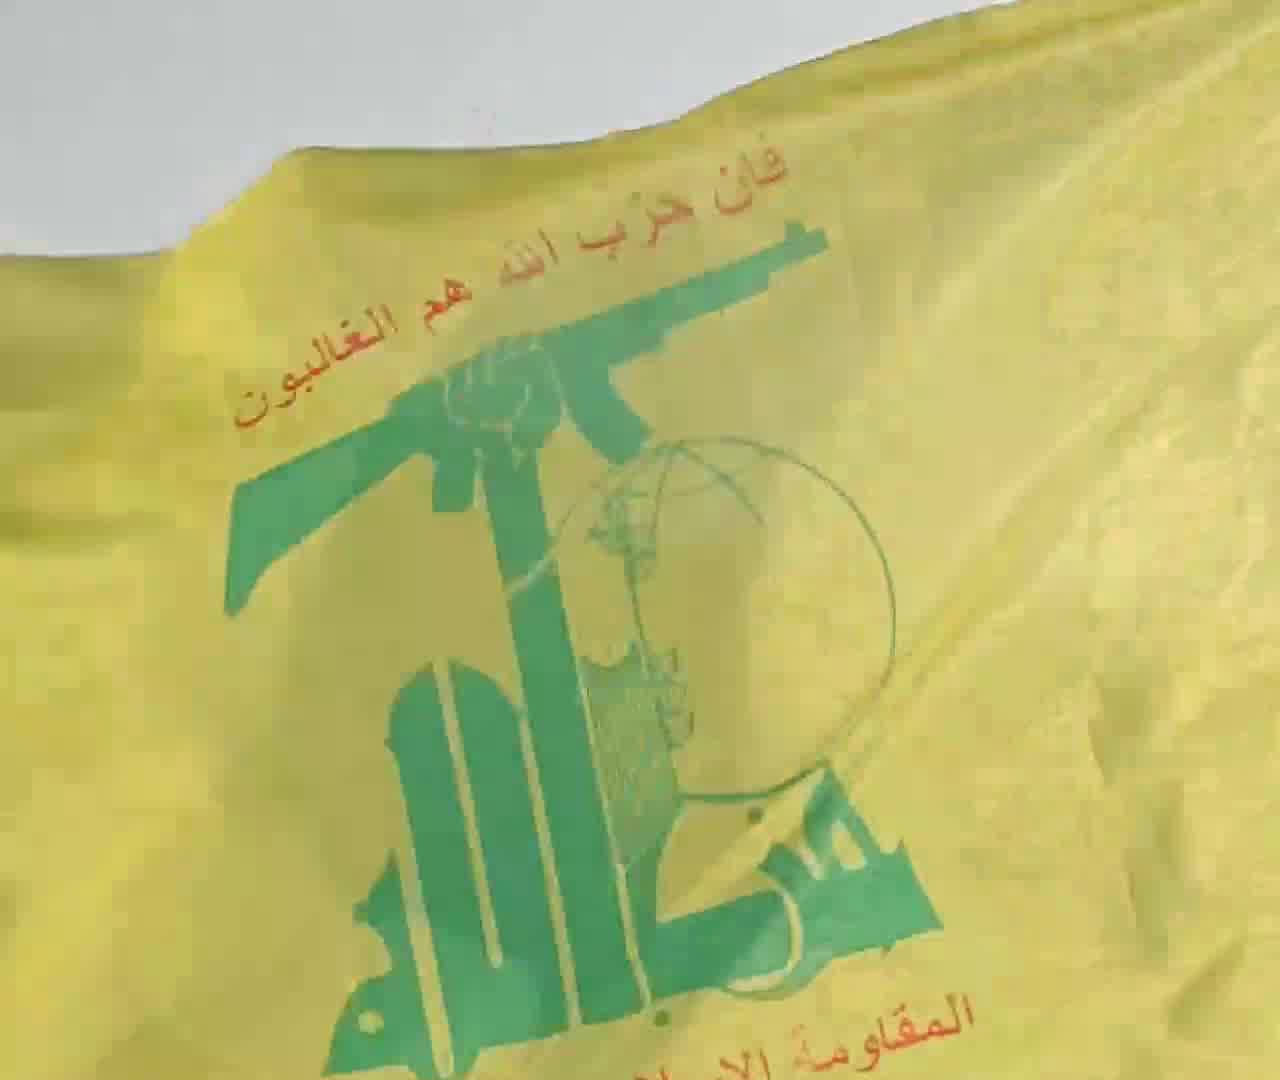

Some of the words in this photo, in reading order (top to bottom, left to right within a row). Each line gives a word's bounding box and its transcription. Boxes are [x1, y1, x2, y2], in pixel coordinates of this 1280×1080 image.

[500, 228, 559, 285] الله
[423, 276, 473, 336] هم
[791, 993, 974, 1073] المقاومة
